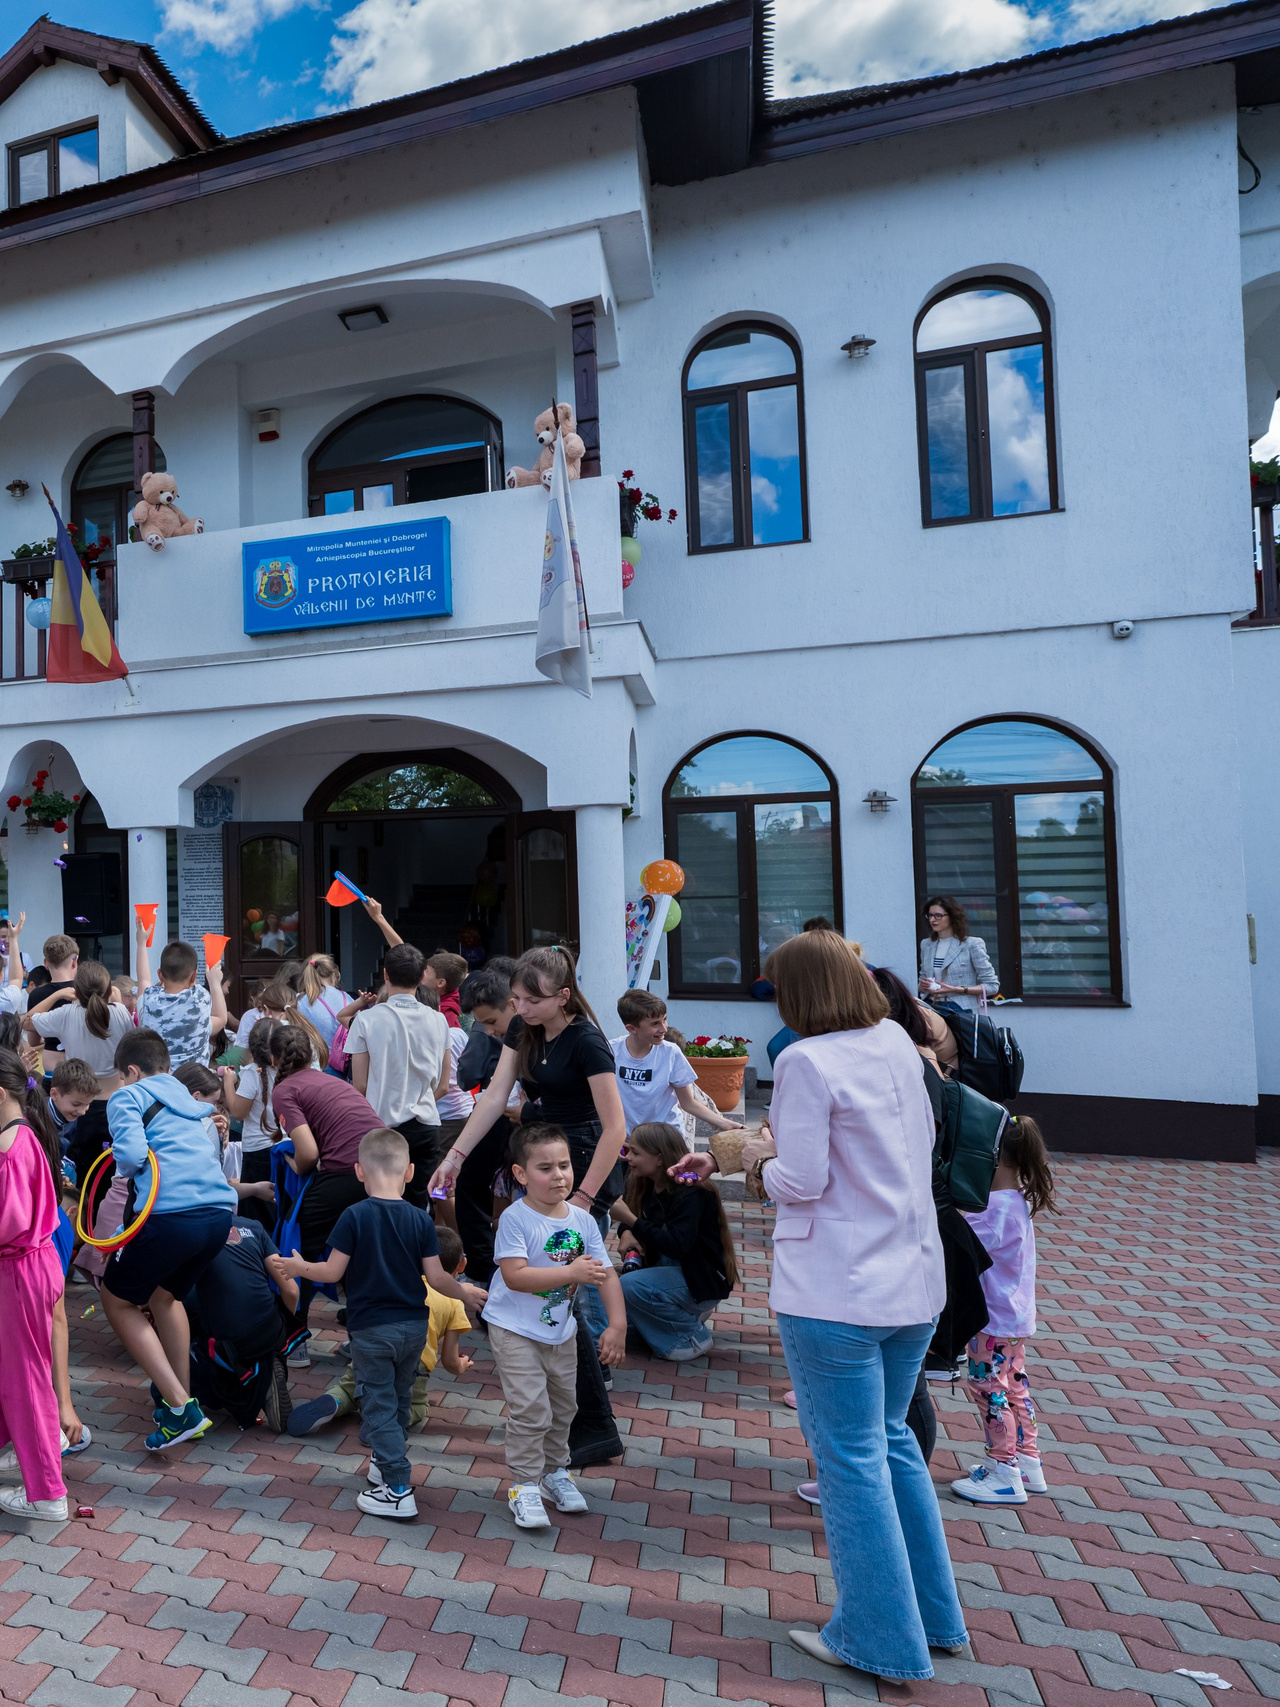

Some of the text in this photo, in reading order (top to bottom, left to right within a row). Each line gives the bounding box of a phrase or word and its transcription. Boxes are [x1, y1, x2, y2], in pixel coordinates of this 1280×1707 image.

[307, 543, 343, 552] Mitropolia
[345, 538, 382, 548] Munteniei
[392, 532, 428, 542] Dobrogei
[315, 550, 367, 562] Arhiepiscopia
[308, 564, 432, 593] PROTOIERIA
[356, 596, 375, 609] DE
[383, 590, 437, 606] MUNTE
[624, 1069, 646, 1080] NYC
